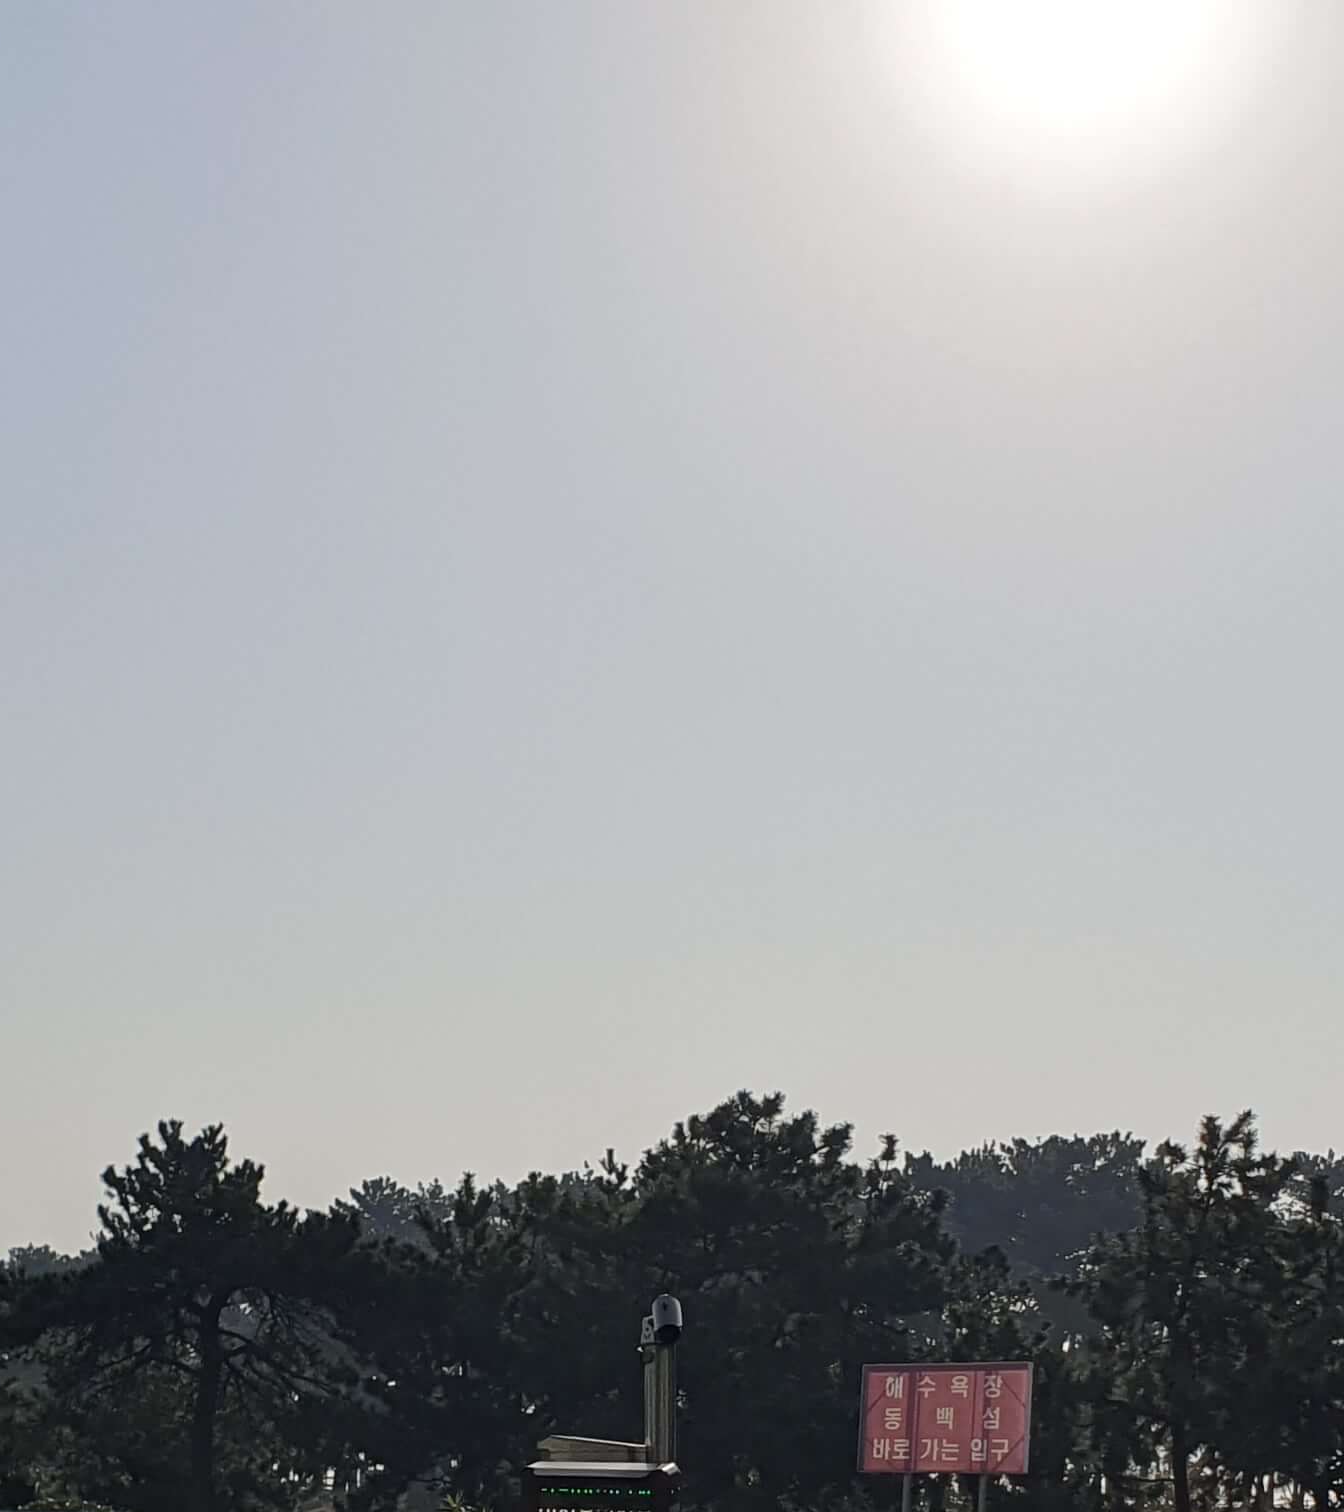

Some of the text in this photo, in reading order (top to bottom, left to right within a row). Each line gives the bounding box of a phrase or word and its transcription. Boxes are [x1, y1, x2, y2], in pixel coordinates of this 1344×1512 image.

[884, 1374, 1004, 1399] 해수욕장
[883, 1406, 1001, 1431] 동백섬
[871, 1438, 1010, 1462] 바로 가는 입구
